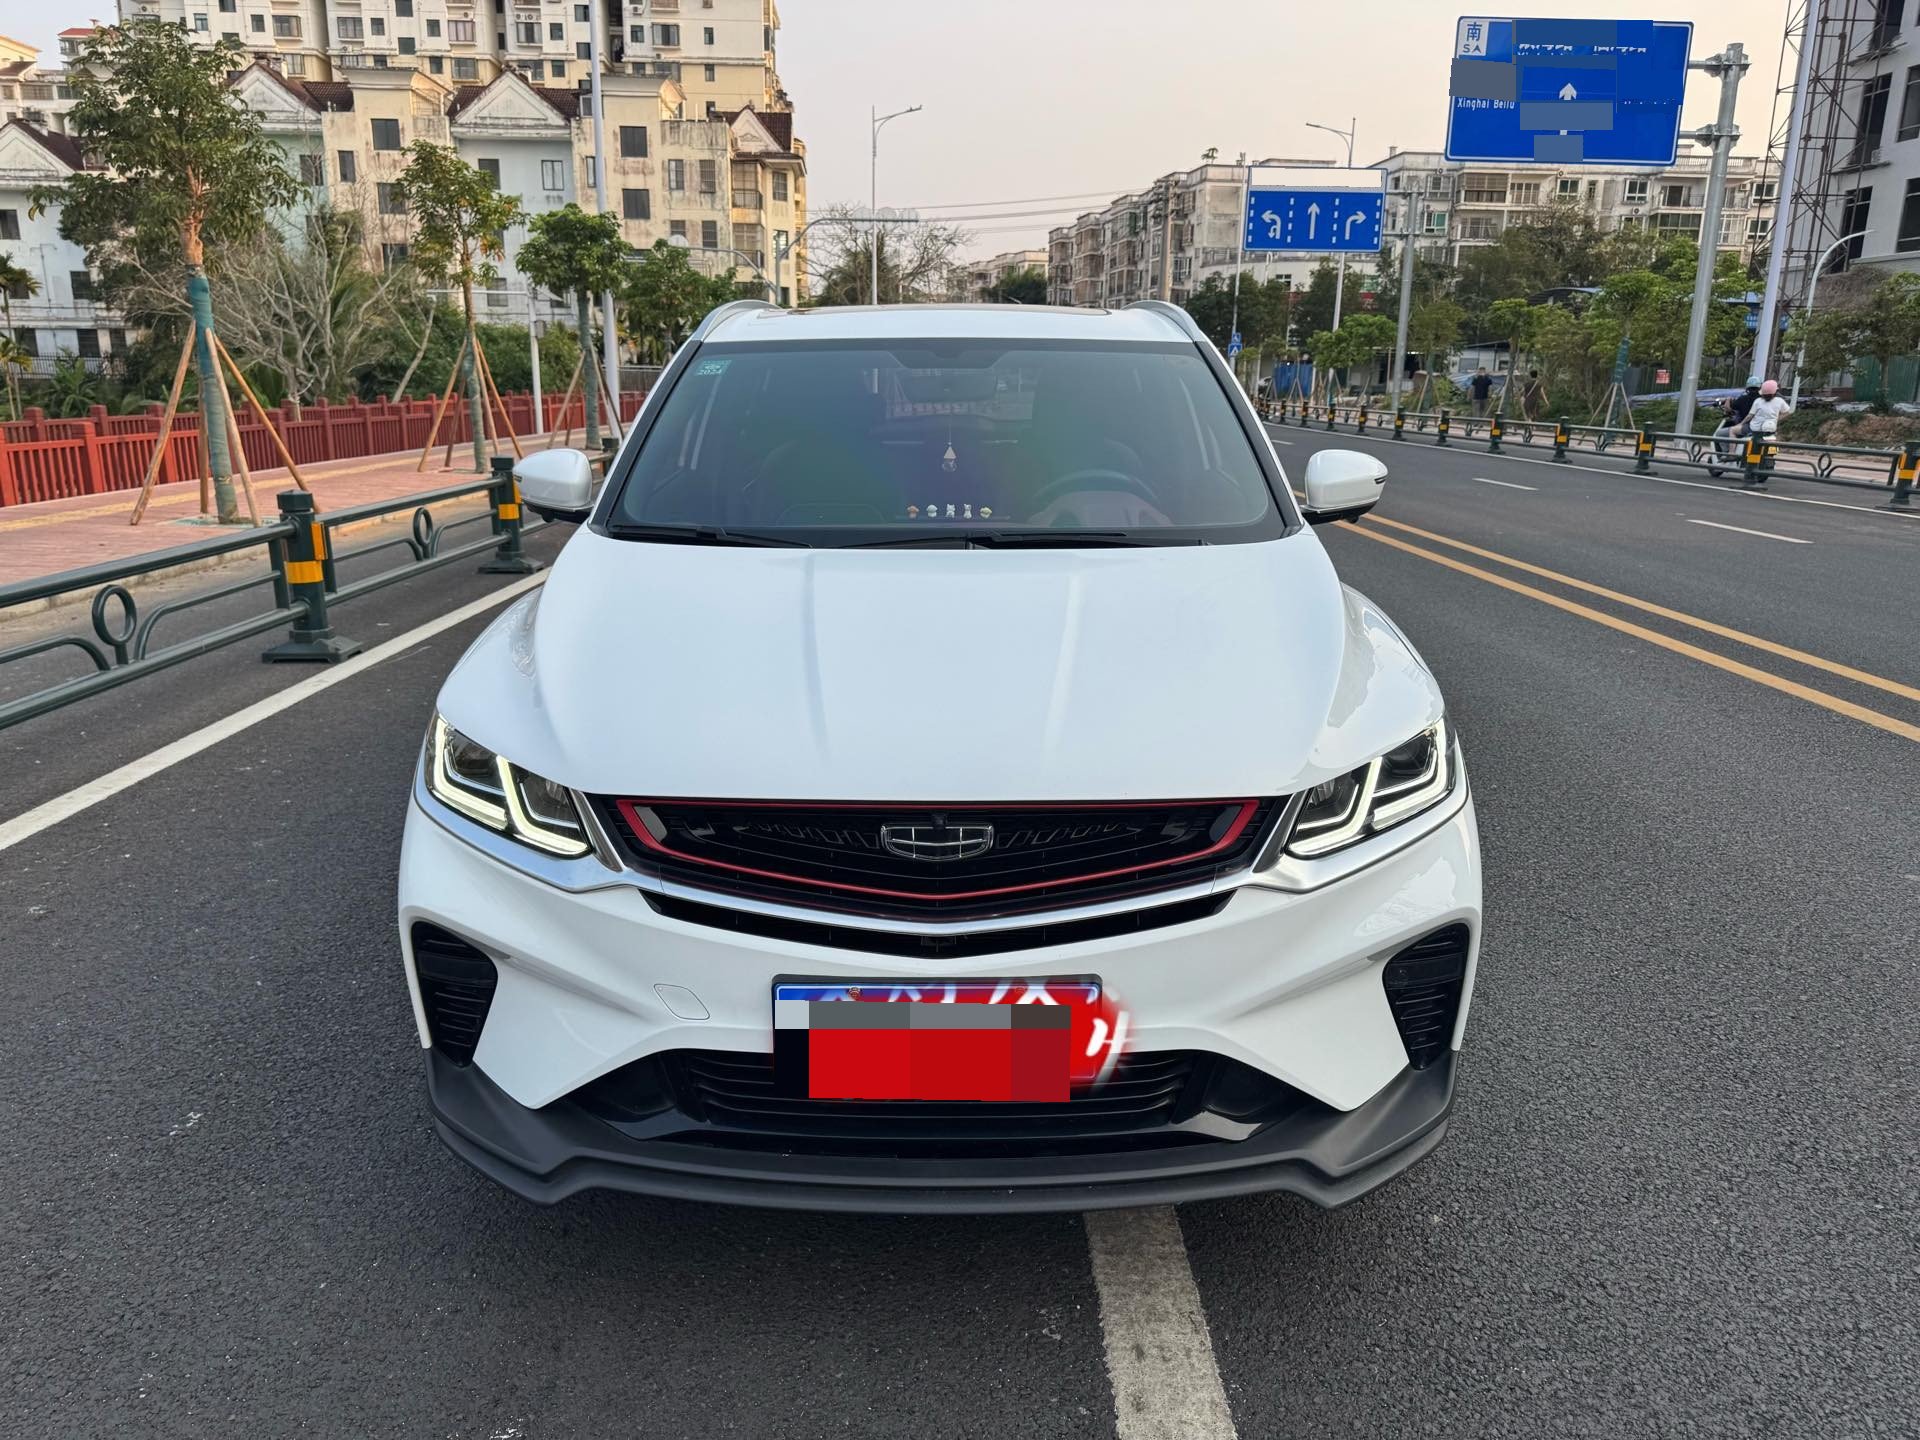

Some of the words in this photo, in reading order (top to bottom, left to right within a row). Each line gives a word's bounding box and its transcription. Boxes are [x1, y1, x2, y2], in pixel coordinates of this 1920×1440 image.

[1467, 22, 1483, 41] 南
[1463, 44, 1482, 53] SA
[1457, 97, 1490, 111] Xinghai
[1493, 99, 1516, 109] Beilu
